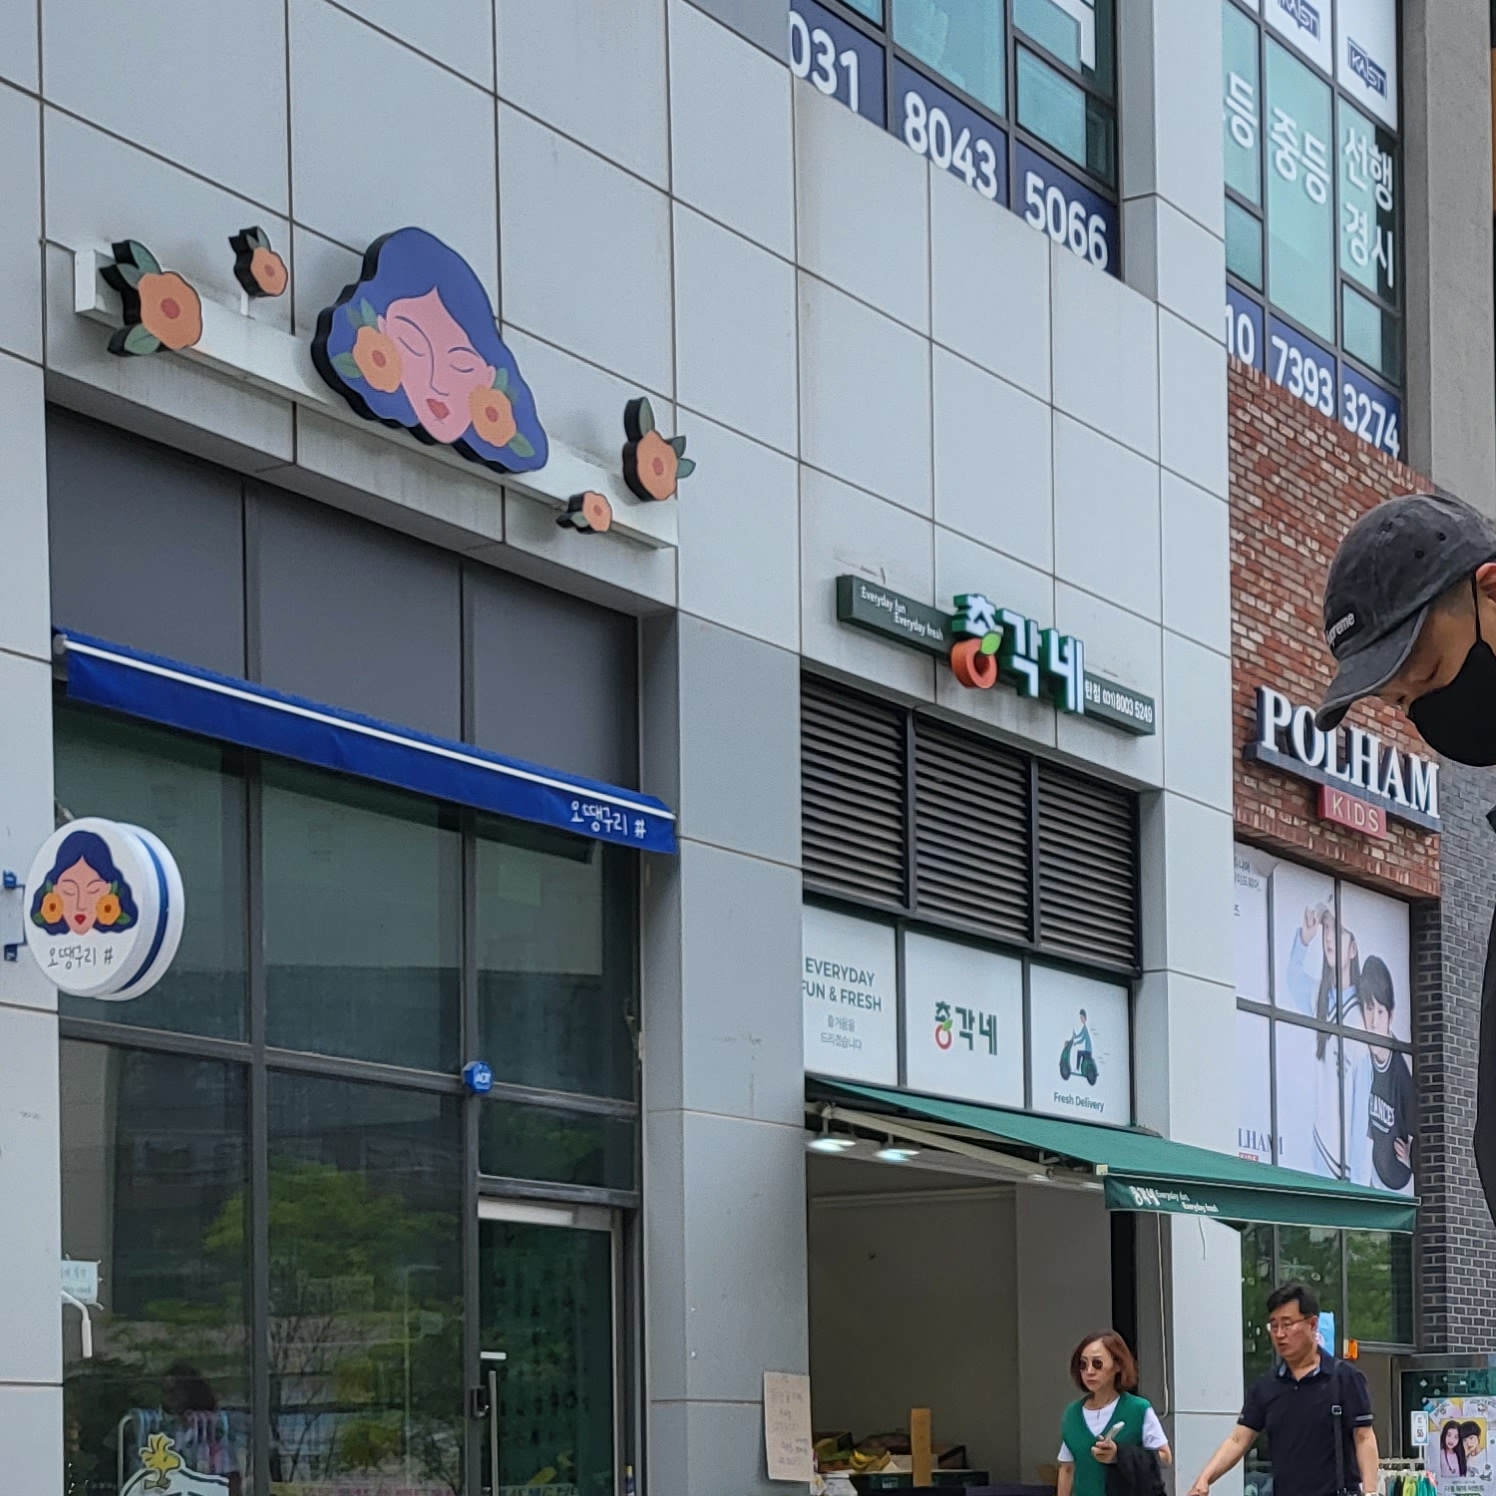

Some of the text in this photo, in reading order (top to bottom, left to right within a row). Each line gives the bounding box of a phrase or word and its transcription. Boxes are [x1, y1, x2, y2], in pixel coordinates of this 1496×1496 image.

[1350, 46, 1386, 96] KAIST
[789, 11, 1108, 271] 031 8043 5066
[1224, 72, 1330, 205] 등 중등
[1343, 125, 1393, 211] 선행
[1343, 202, 1393, 288] 경시
[1271, 335, 1334, 418] 7393
[1342, 383, 1400, 458] 3274
[860, 585, 893, 613] Everyday
[894, 611, 926, 638] Everyday
[951, 593, 1085, 714] 총각네
[1134, 700, 1153, 724] 5249
[1257, 684, 1441, 819] POLHAM
[570, 800, 628, 837] 오땡구리
[1331, 793, 1379, 832] KIDS
[805, 956, 875, 988] EVERYDAY
[829, 985, 838, 1002] &
[840, 988, 882, 1012] FRESH
[934, 1001, 998, 1056] 총각네
[1053, 1091, 1105, 1113] Fresh Delivery
